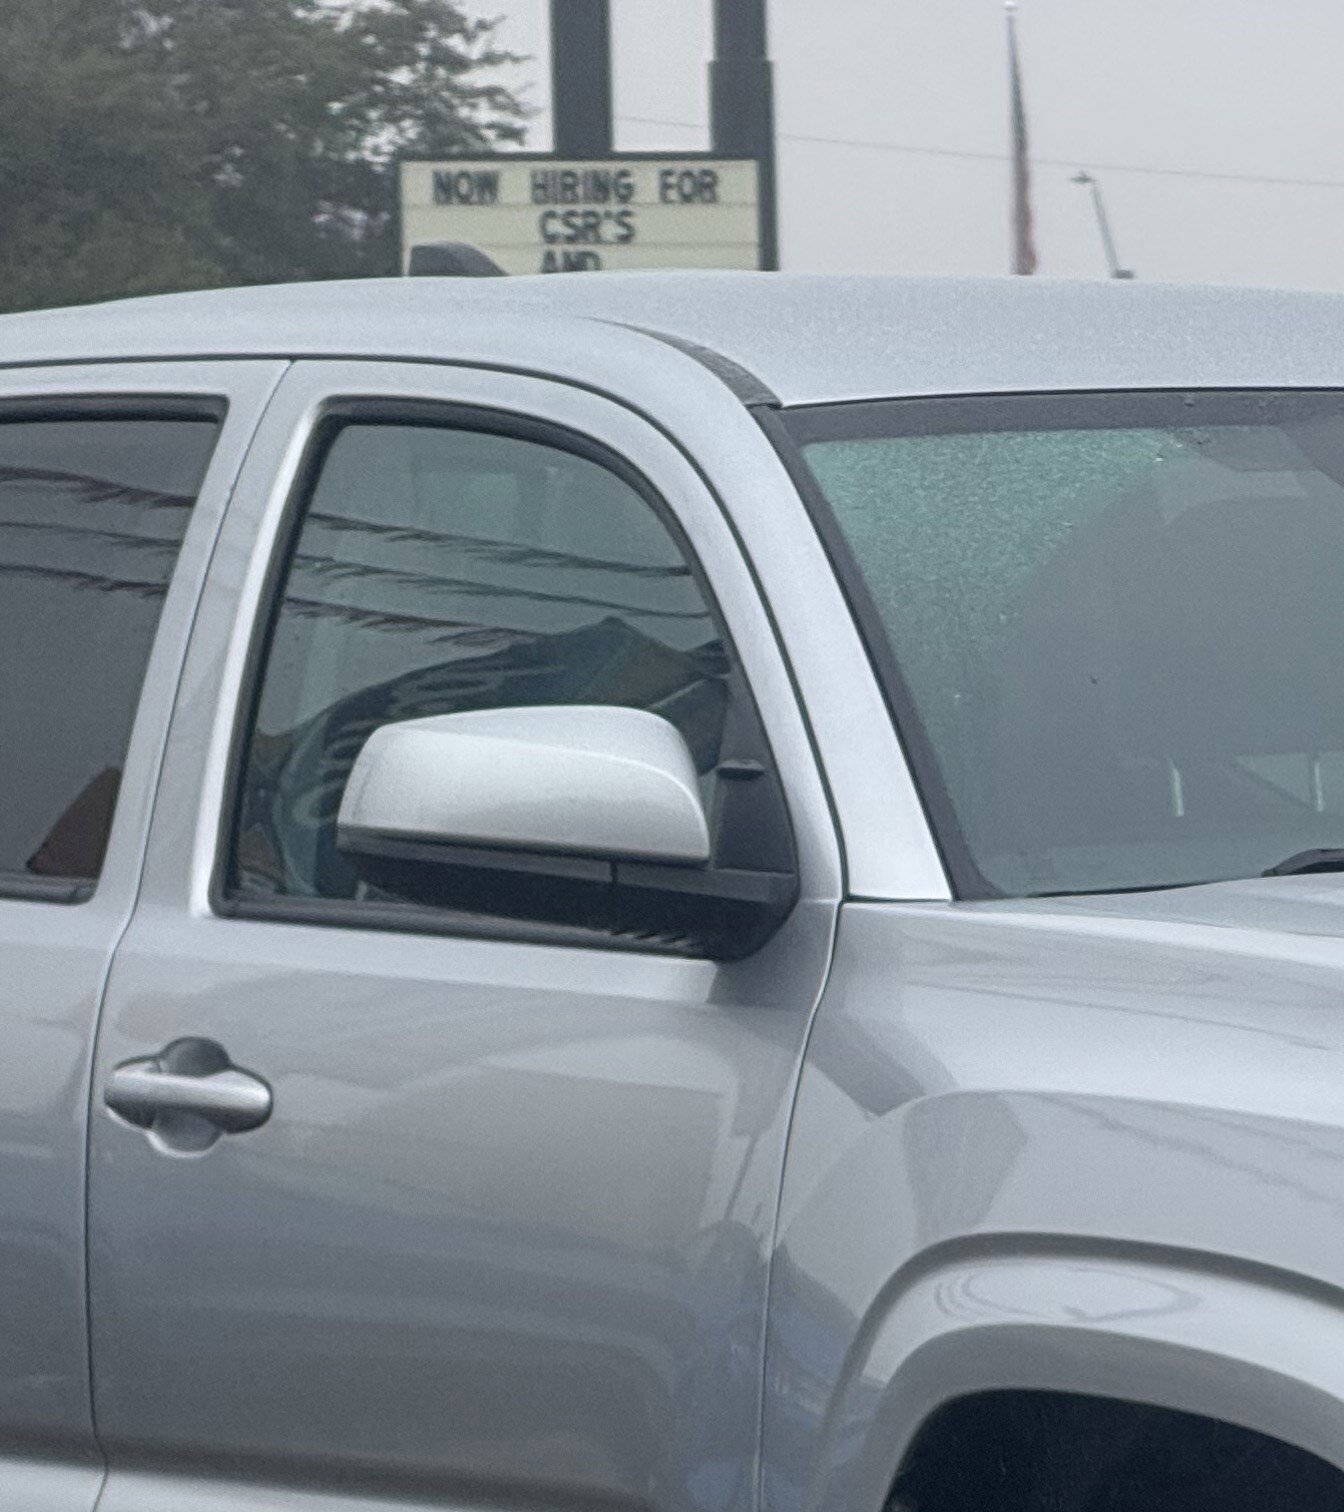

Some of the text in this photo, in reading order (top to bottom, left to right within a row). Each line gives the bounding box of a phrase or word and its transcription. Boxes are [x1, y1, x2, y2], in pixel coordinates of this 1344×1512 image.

[433, 168, 719, 204] NOW HIRING FOR
[539, 209, 635, 244] CSR'S
[541, 250, 601, 273] AND
